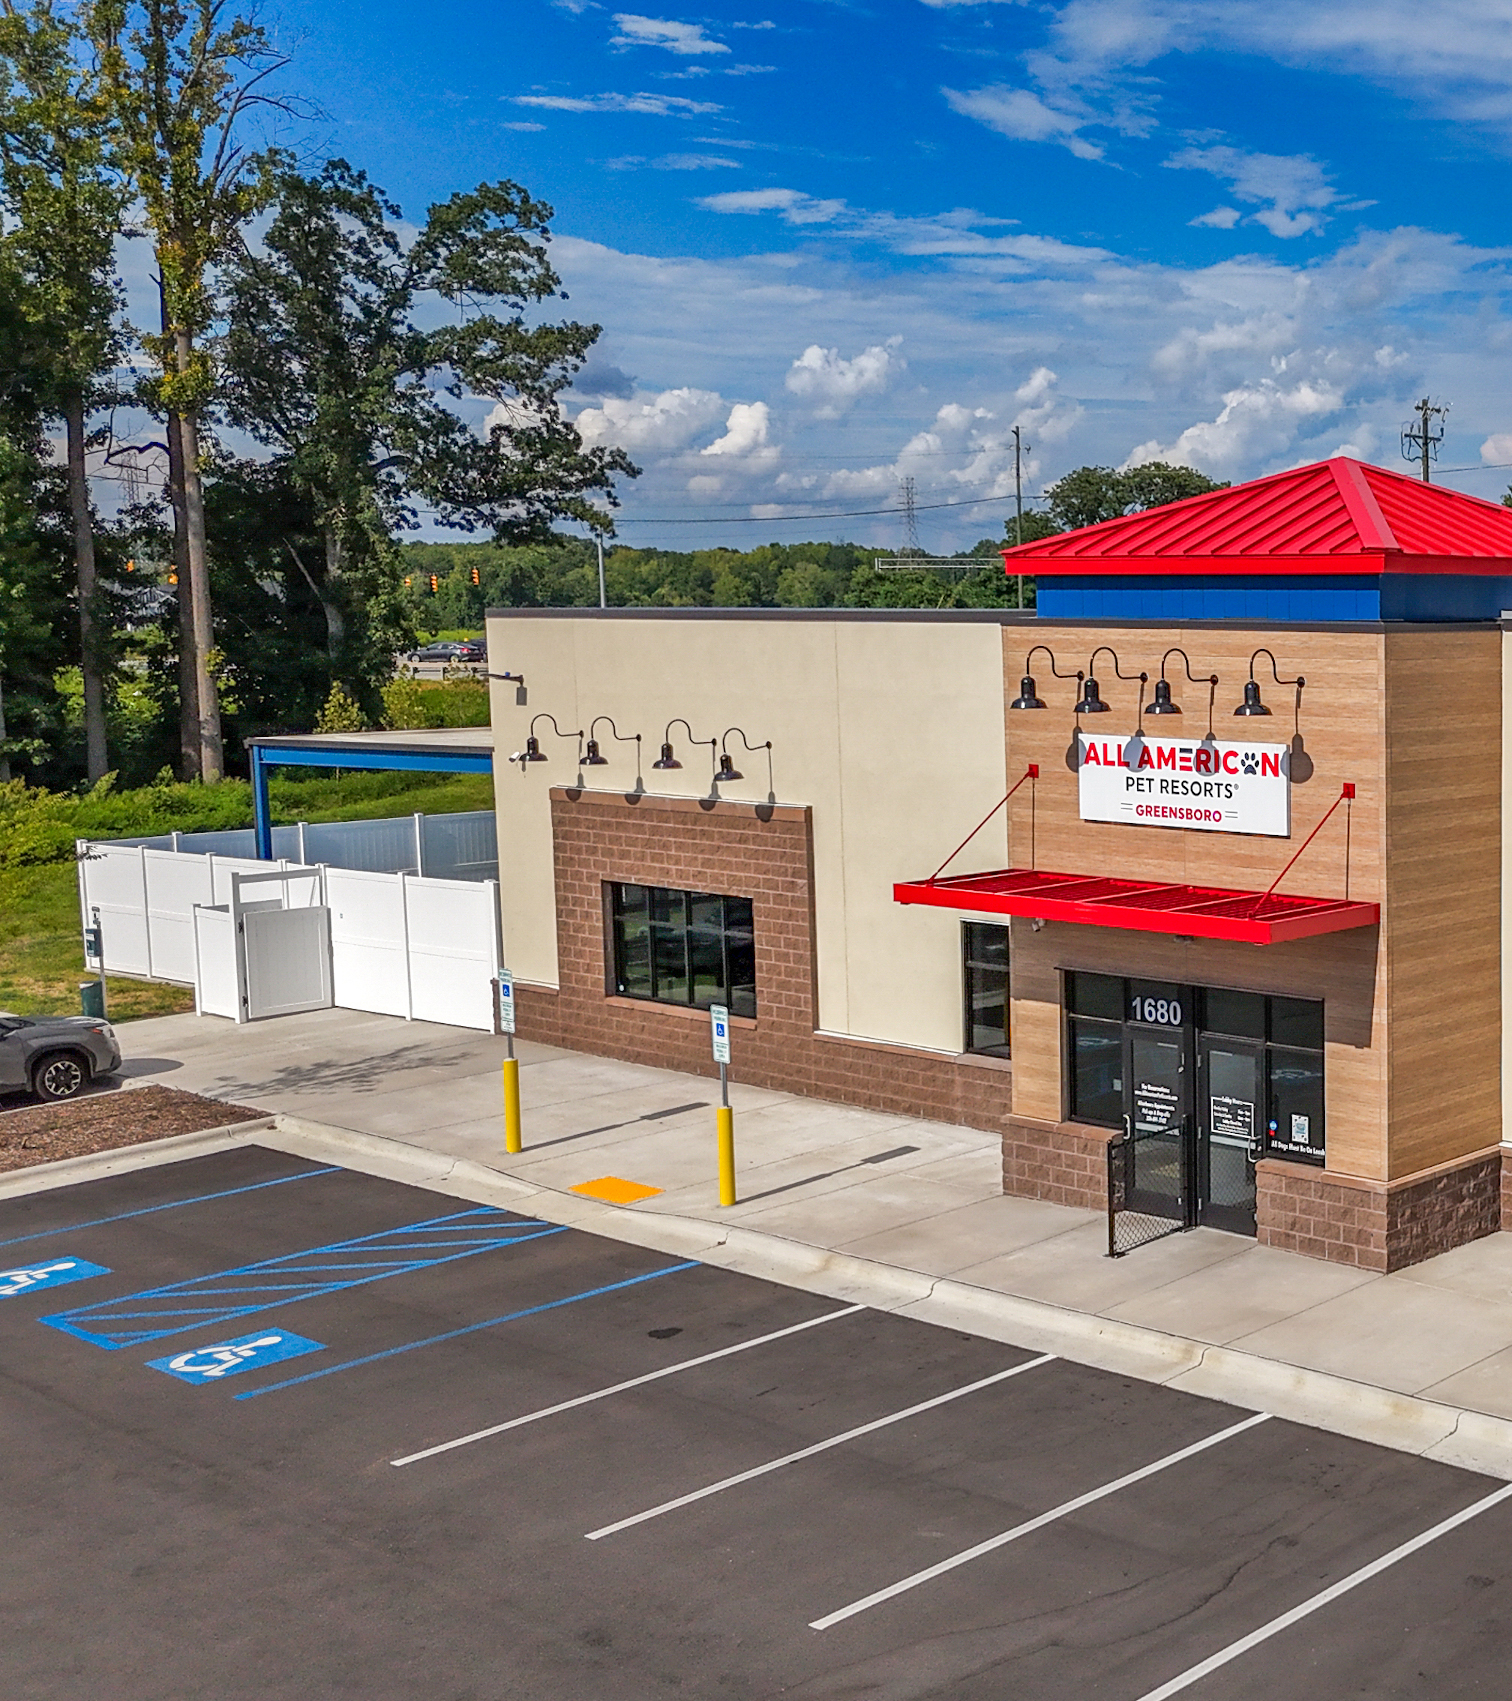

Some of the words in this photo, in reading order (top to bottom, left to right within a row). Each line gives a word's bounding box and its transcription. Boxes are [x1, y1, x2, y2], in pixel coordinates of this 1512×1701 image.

[1083, 742, 1130, 767] ALL
[1137, 745, 1280, 778] AMERICN
[1125, 776, 1155, 793] PET
[1135, 804, 1222, 823] GREENSBORO
[1131, 996, 1181, 1026] 1680
